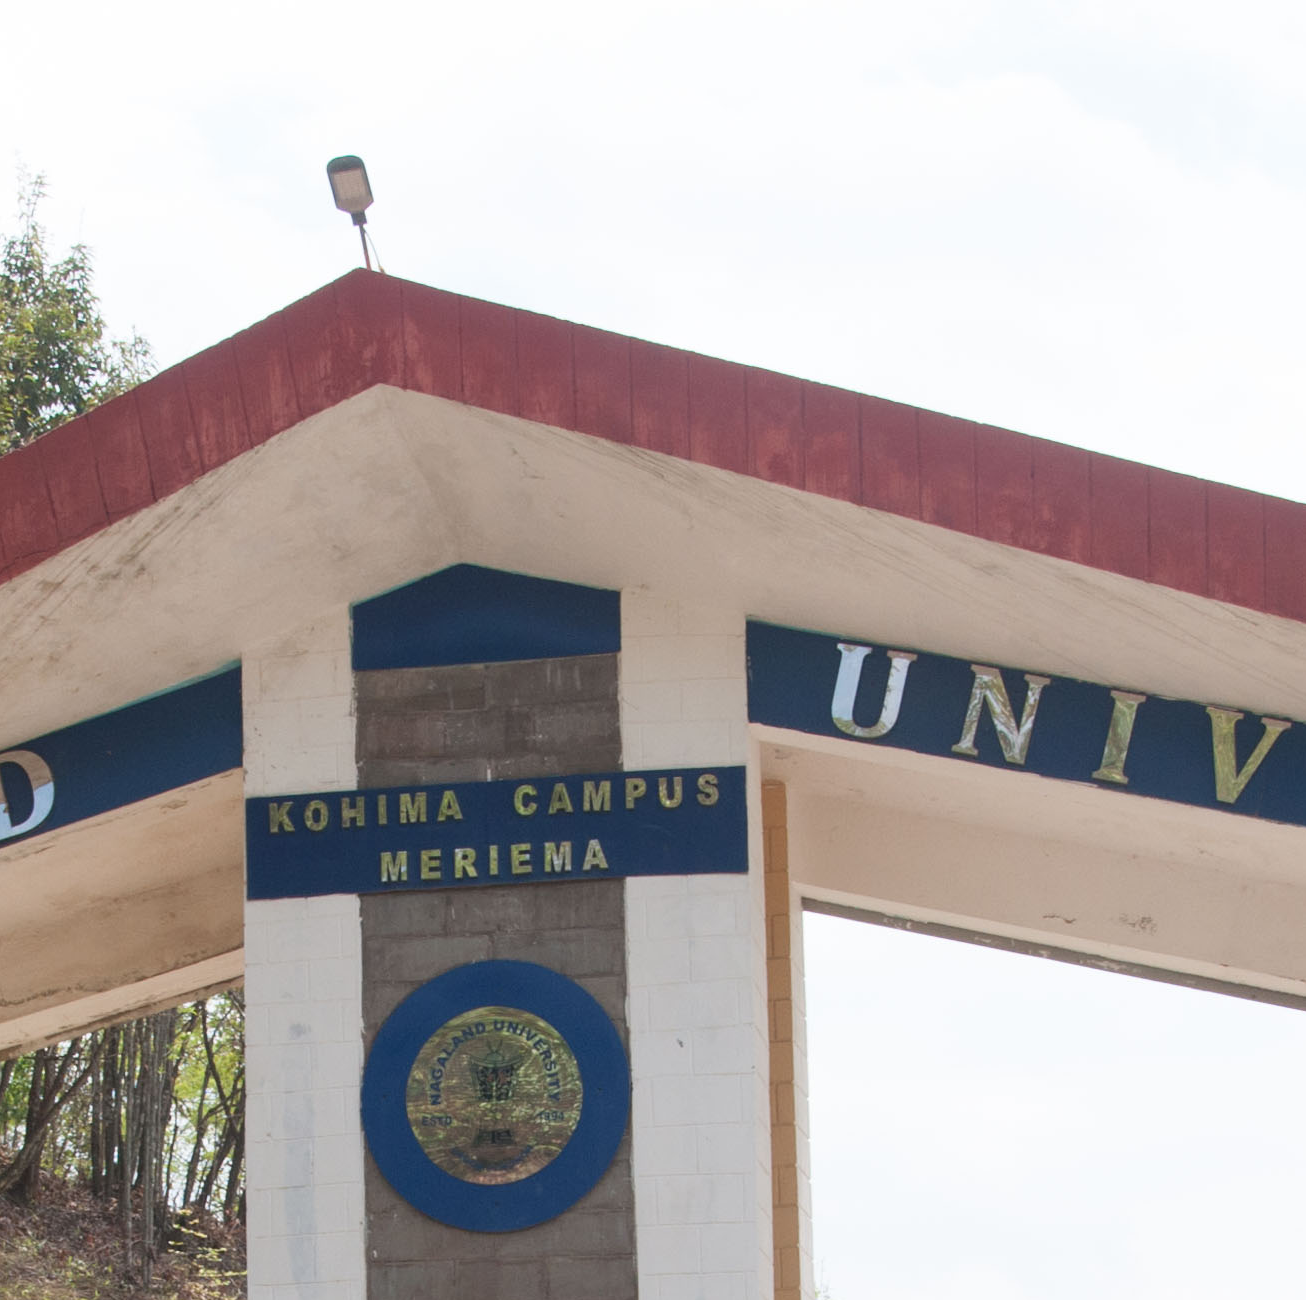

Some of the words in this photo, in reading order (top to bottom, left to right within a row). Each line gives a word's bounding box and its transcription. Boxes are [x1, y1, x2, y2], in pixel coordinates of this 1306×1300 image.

[269, 789, 464, 833] KOHIMA
[513, 773, 720, 817] CAMPUS
[380, 838, 610, 883] MERIEMA
[429, 1021, 486, 1105] NAGALAND
[494, 1020, 561, 1102] UNIVERSITY
[421, 1115, 452, 1127] ESTD
